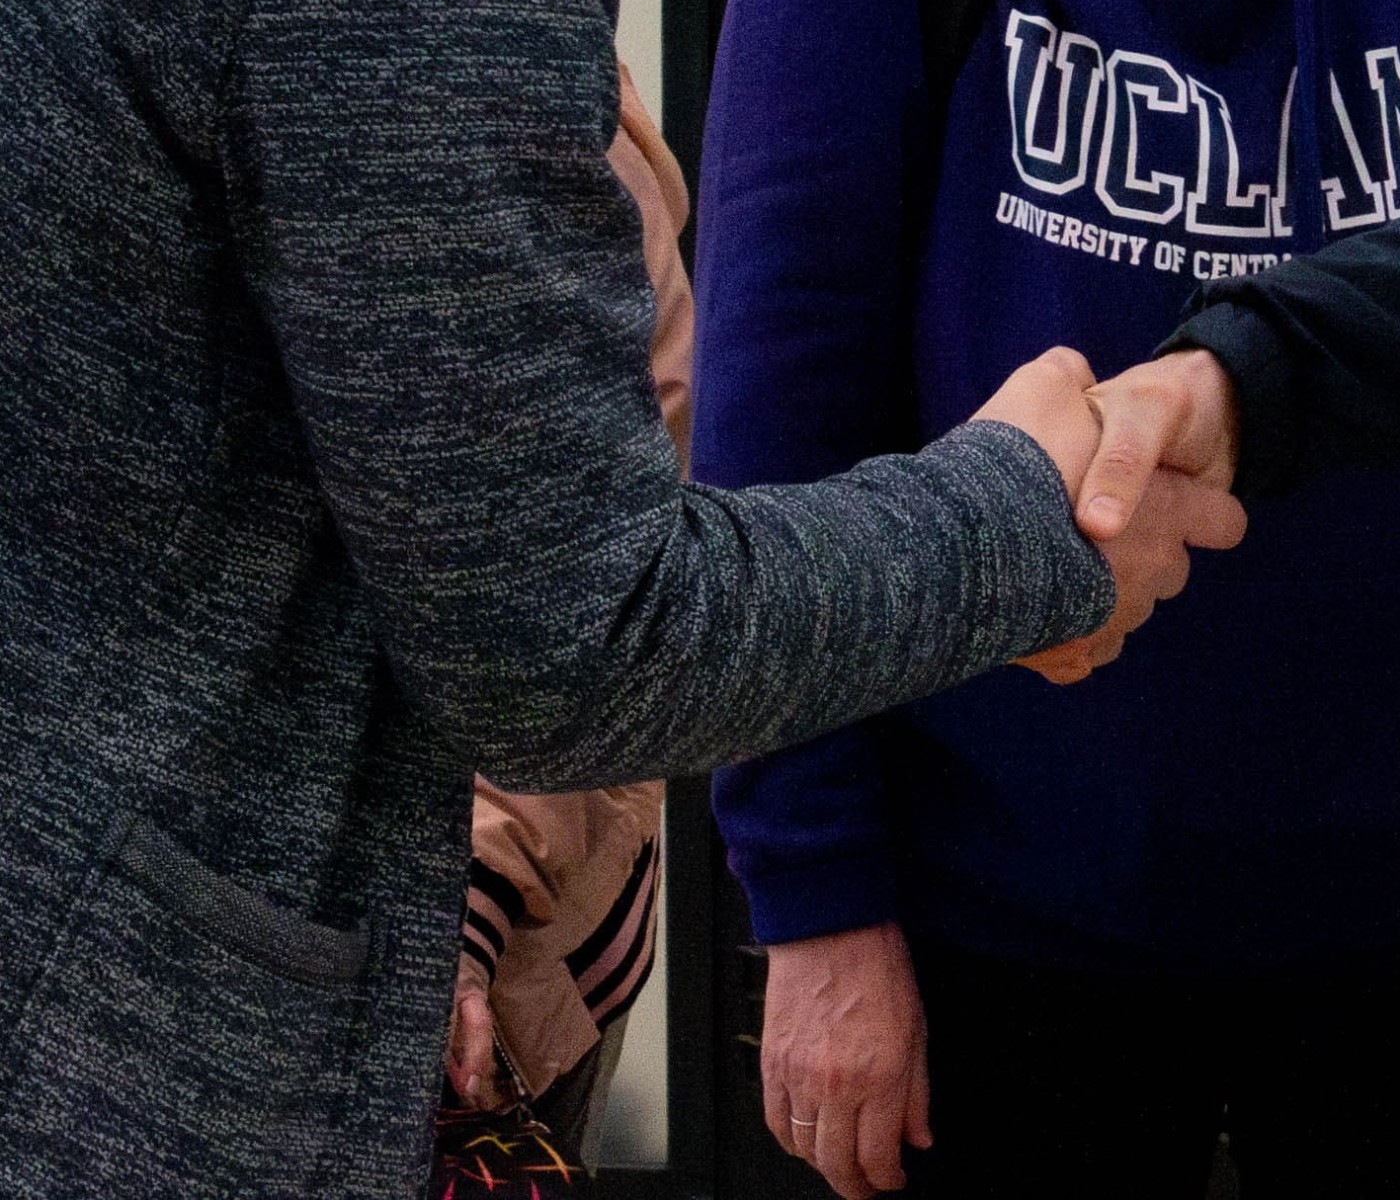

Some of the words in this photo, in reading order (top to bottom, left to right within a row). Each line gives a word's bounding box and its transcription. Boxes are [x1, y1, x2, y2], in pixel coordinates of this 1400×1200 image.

[996, 192, 1148, 266] UNIVERSITY
[1154, 240, 1187, 274] OF
[1193, 250, 1292, 281] CENT
